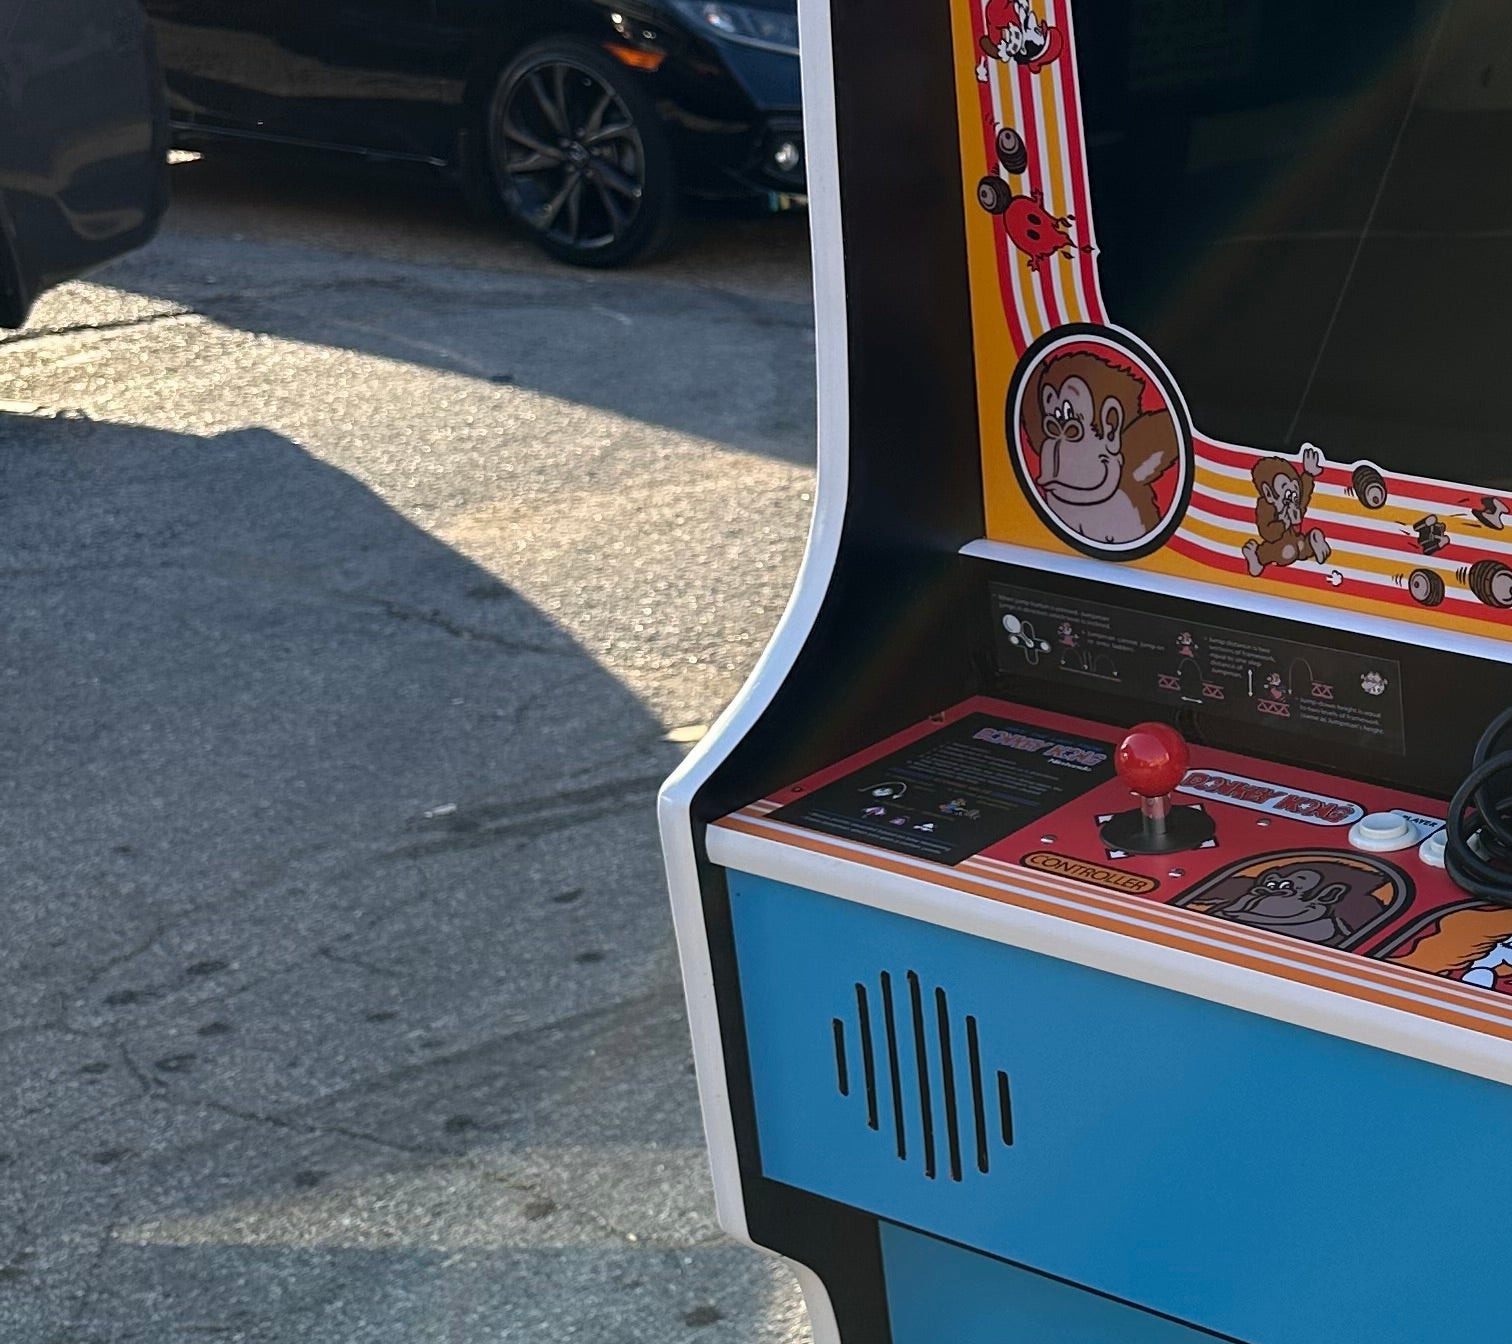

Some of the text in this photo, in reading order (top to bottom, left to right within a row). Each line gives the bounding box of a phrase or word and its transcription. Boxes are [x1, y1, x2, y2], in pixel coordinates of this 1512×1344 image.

[1180, 772, 1355, 823] DONKEY KONG
[1030, 855, 1148, 891] CONTROLLER
